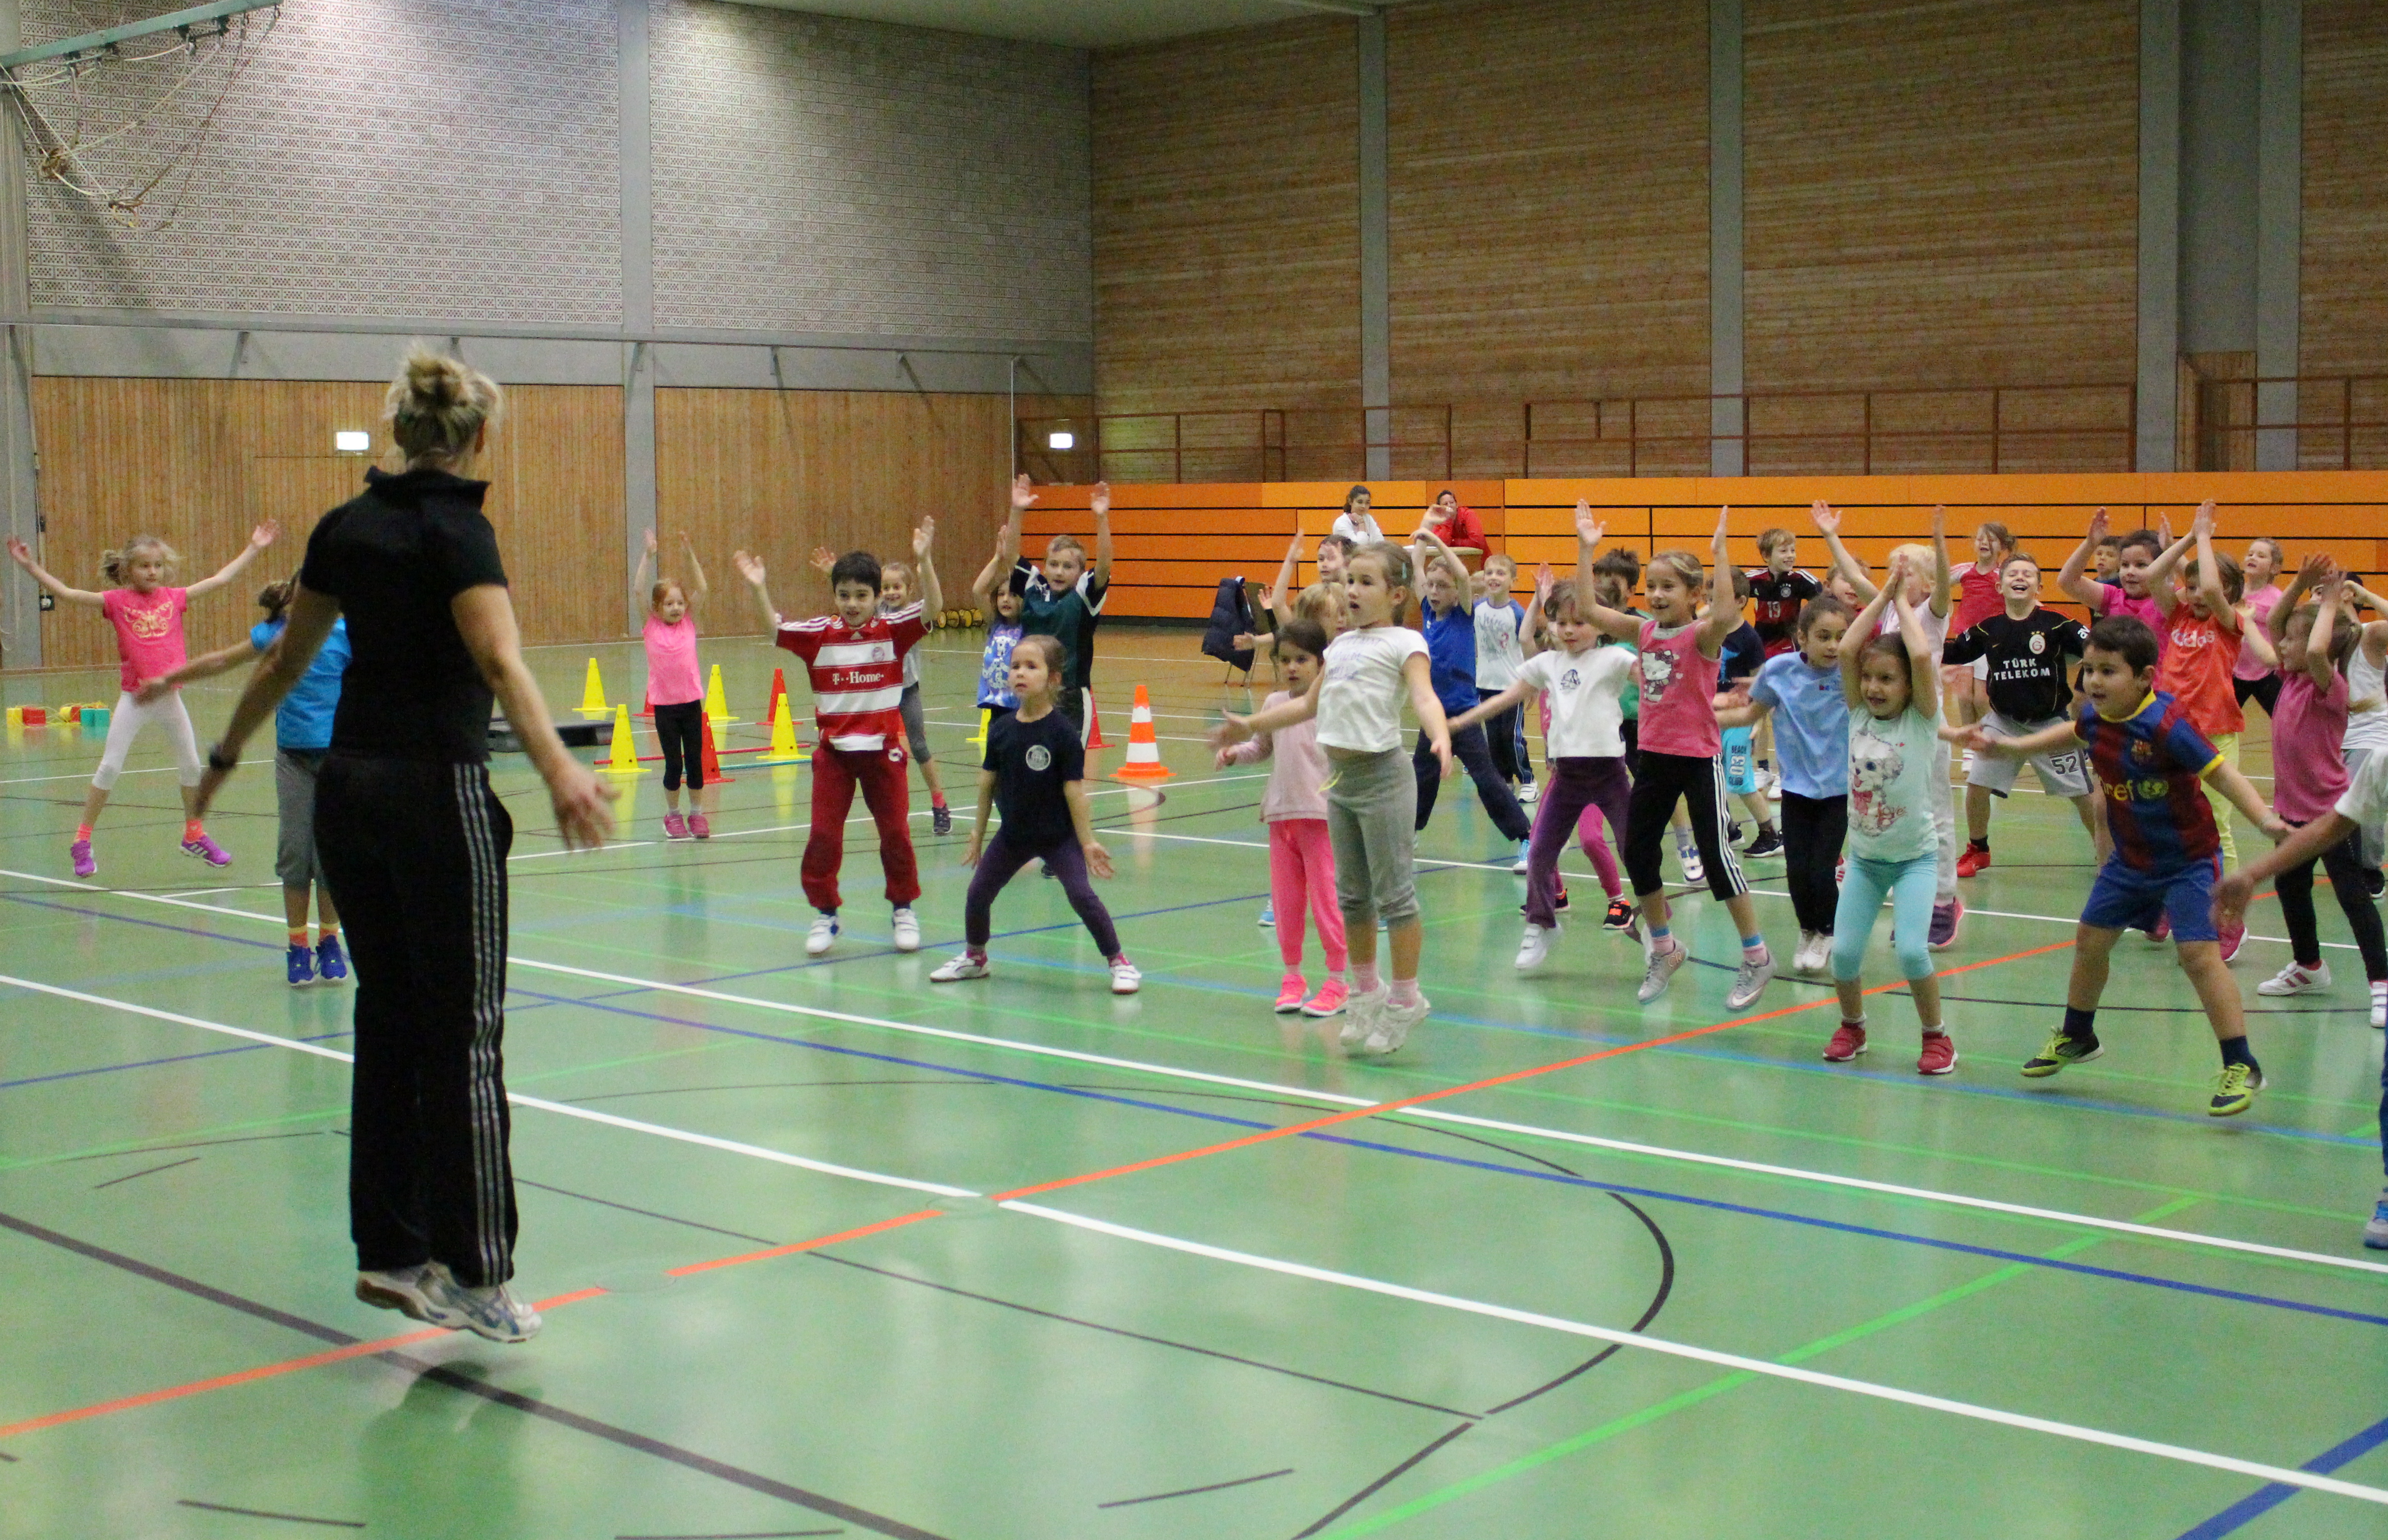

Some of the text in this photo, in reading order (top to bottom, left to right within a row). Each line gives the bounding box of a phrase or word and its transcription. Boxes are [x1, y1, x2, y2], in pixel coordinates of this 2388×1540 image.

[1767, 601, 1781, 618] 19
[1993, 667, 2051, 681] TELEKOM
[2050, 755, 2080, 775] 52
